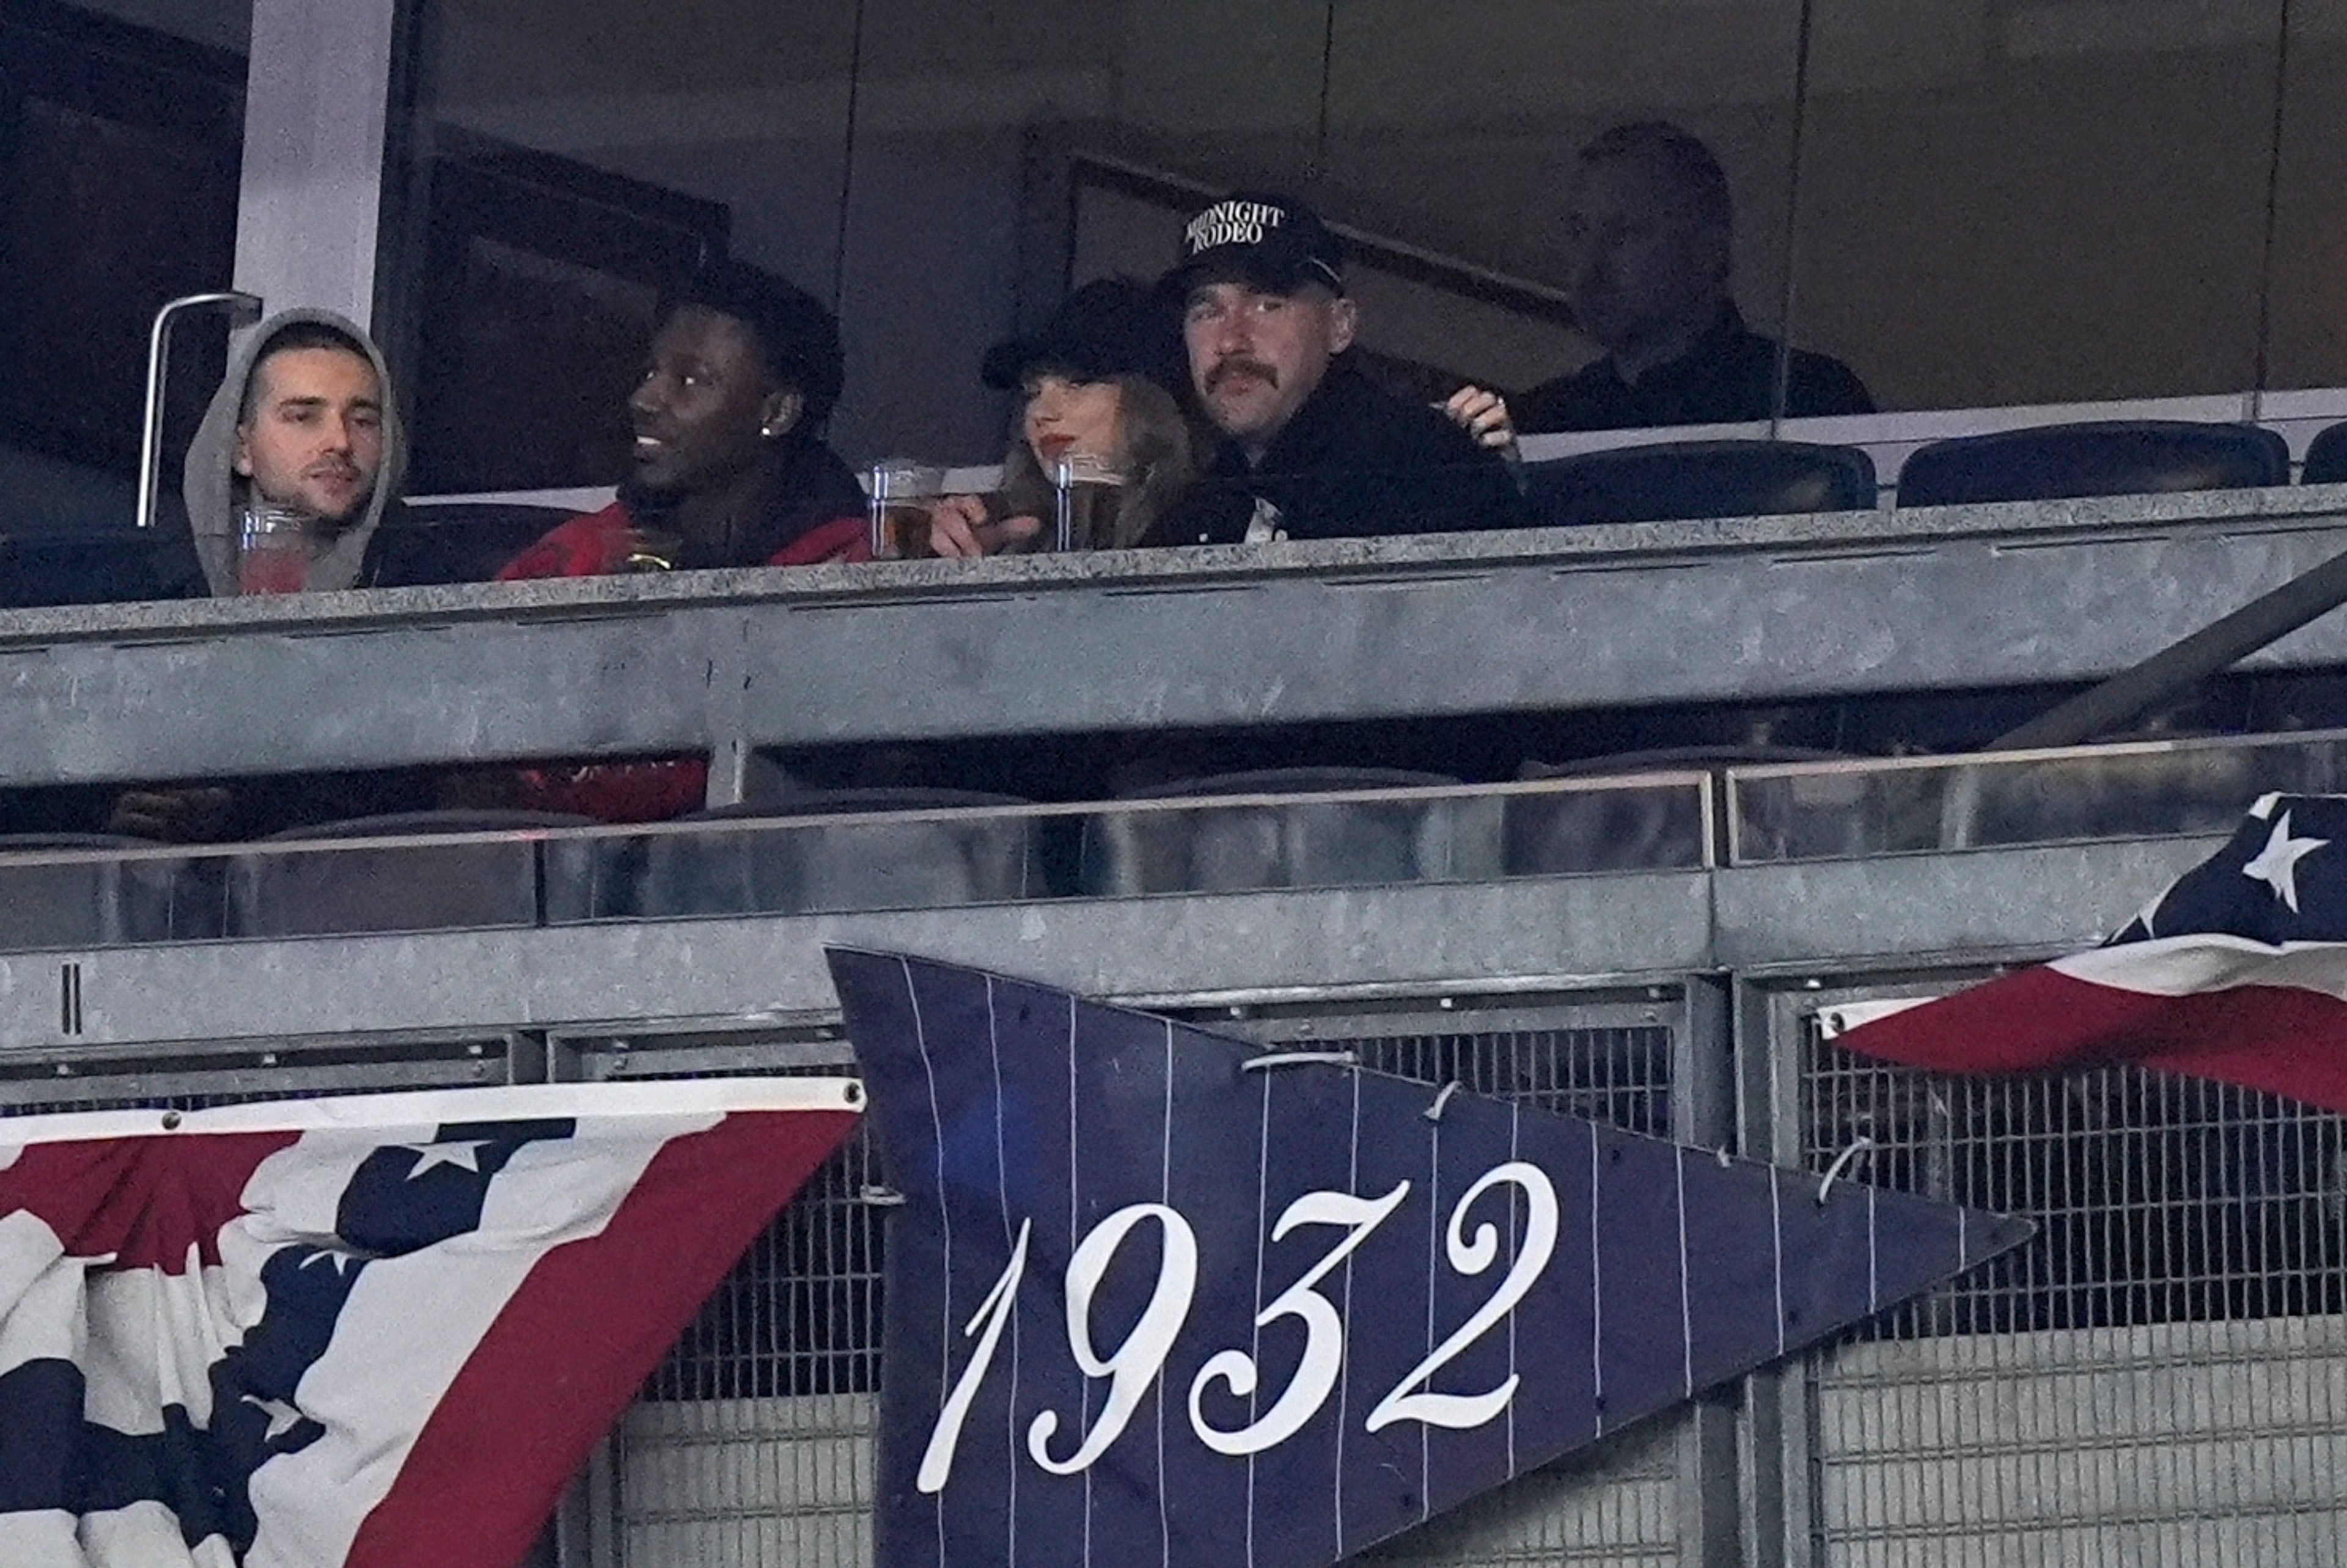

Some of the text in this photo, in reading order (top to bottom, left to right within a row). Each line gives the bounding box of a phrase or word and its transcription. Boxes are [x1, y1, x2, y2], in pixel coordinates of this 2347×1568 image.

[1185, 200, 1285, 243] MIDNIGHT
[1192, 221, 1263, 254] RODEO
[916, 1162, 1559, 1493] 1932
